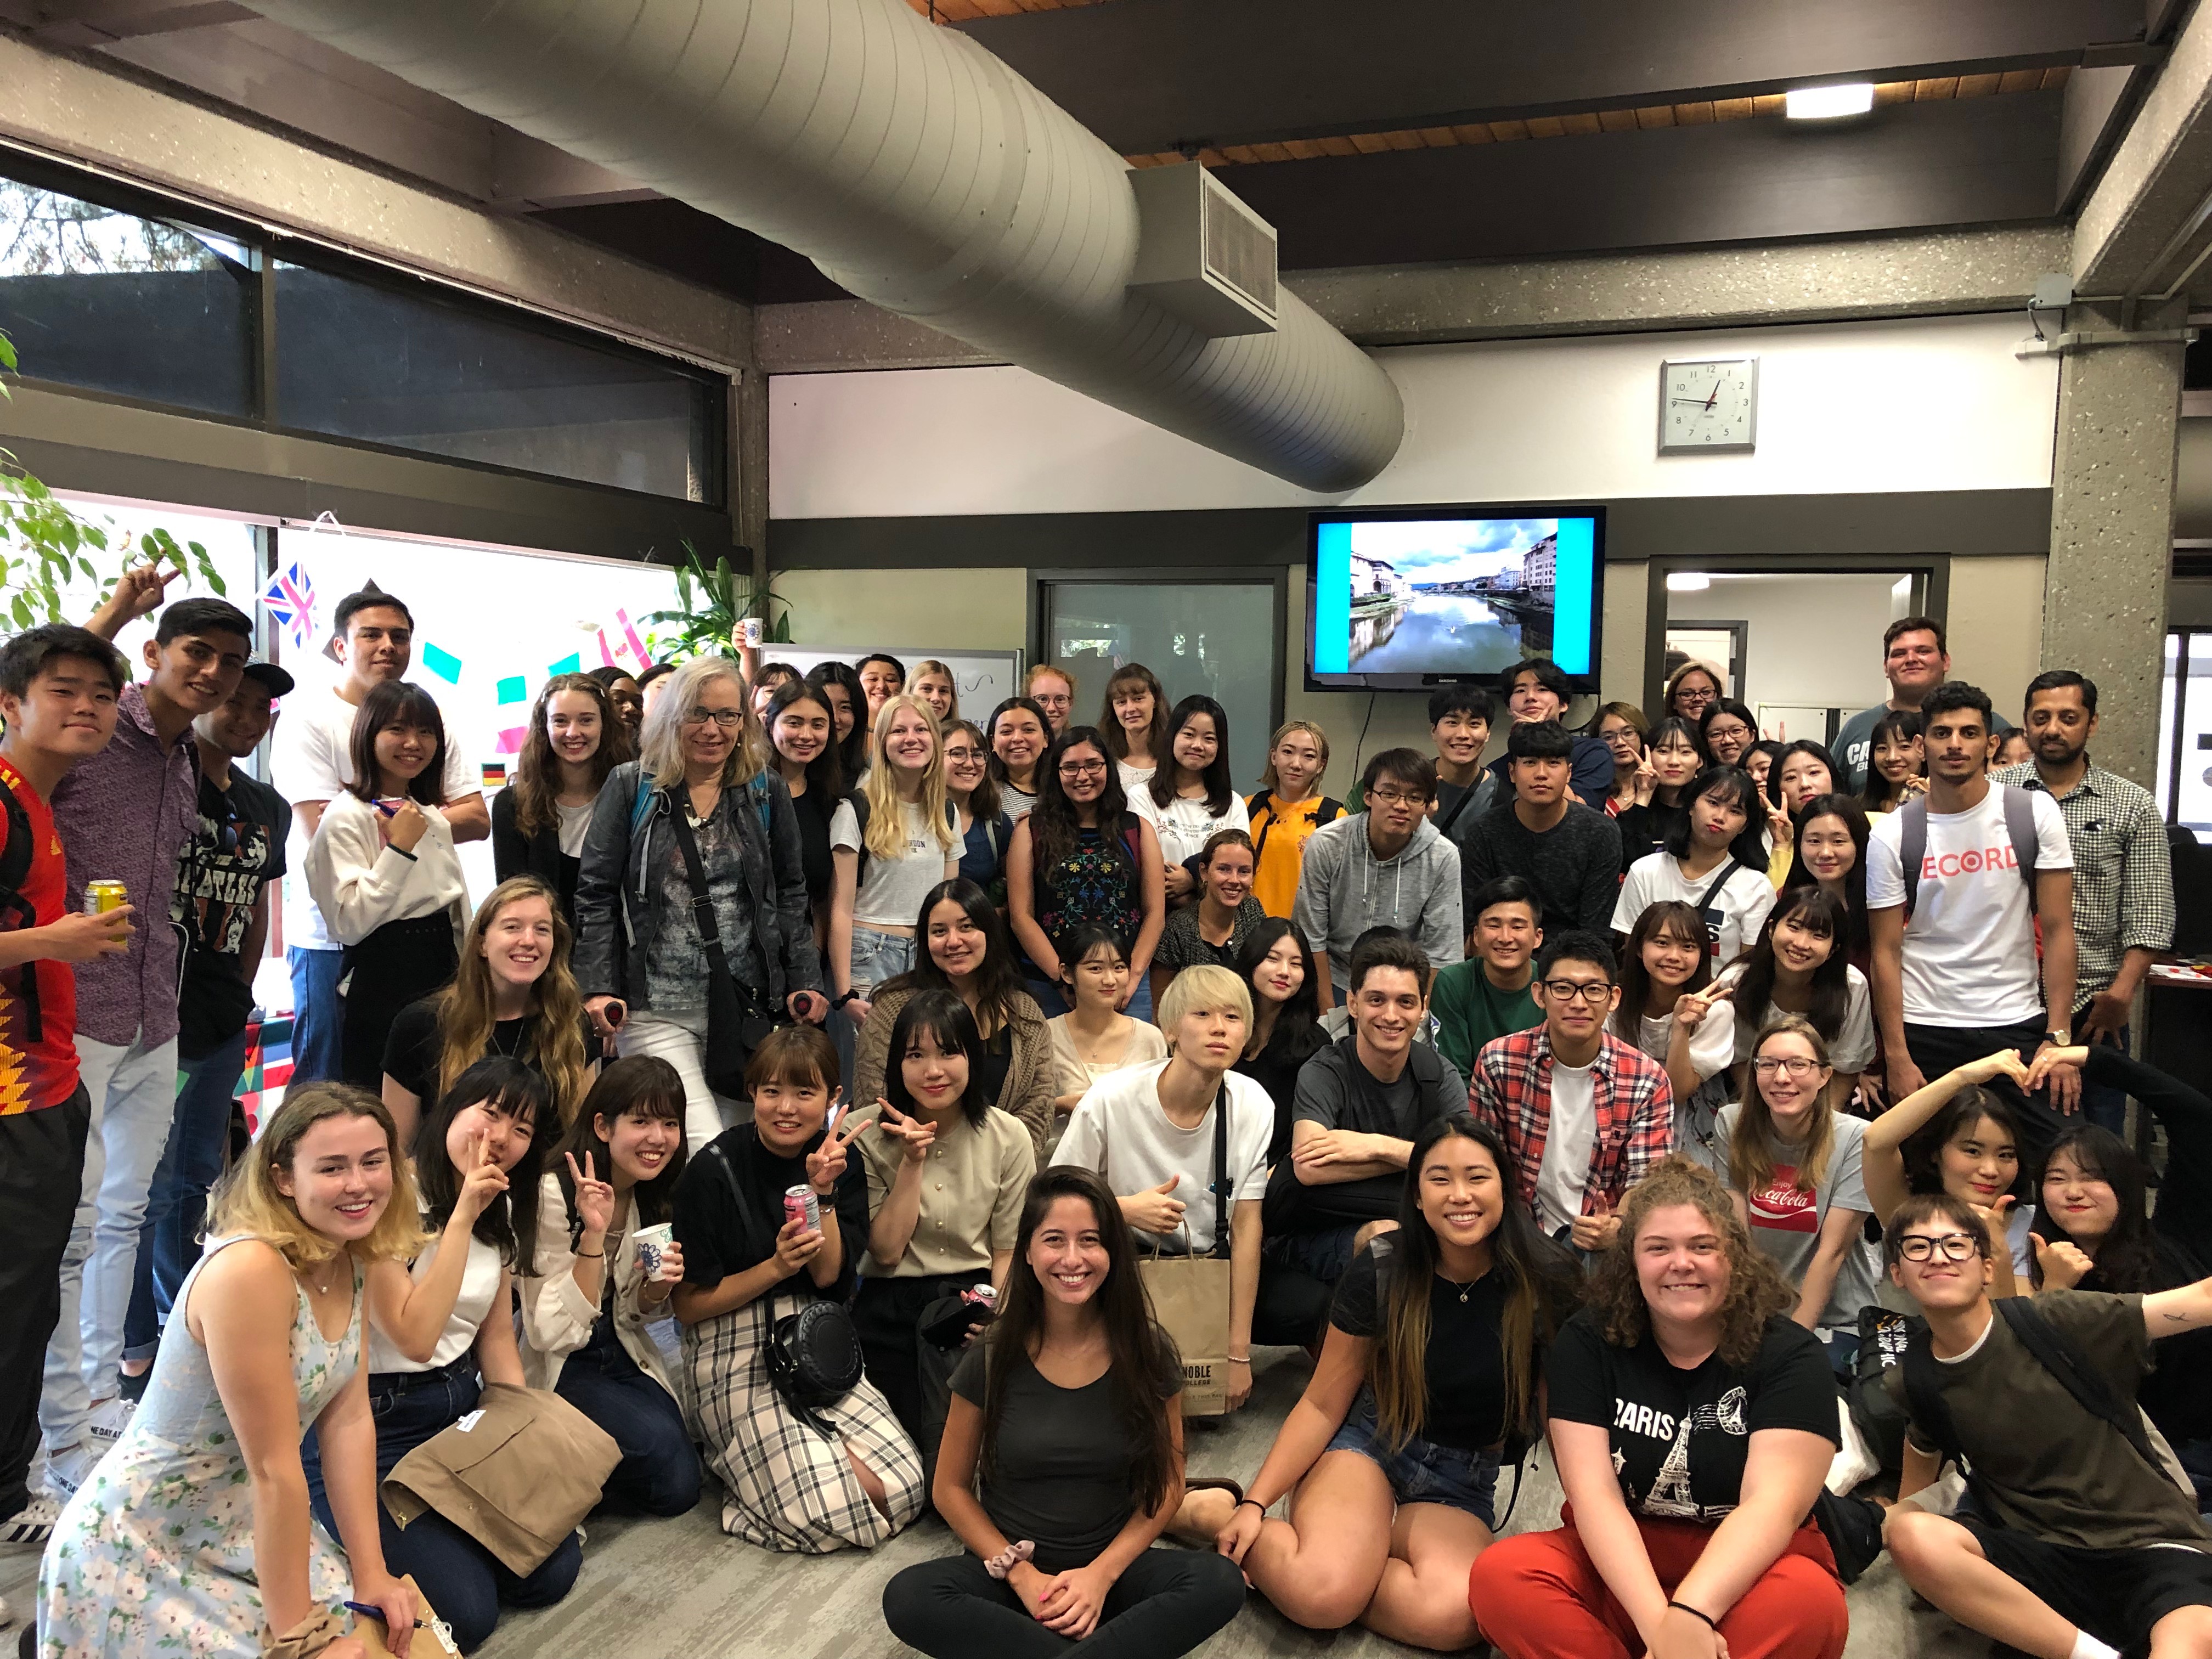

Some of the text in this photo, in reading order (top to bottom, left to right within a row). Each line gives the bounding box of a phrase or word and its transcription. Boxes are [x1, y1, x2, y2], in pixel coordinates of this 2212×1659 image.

[1706, 365, 1716, 374] 12
[1739, 381, 1745, 390] 2
[1742, 398, 1748, 407] 3
[1676, 416, 1681, 425] 8
[1723, 428, 1730, 436] 5
[1705, 433, 1711, 442] 6
[99, 1426, 112, 1437] DAY
